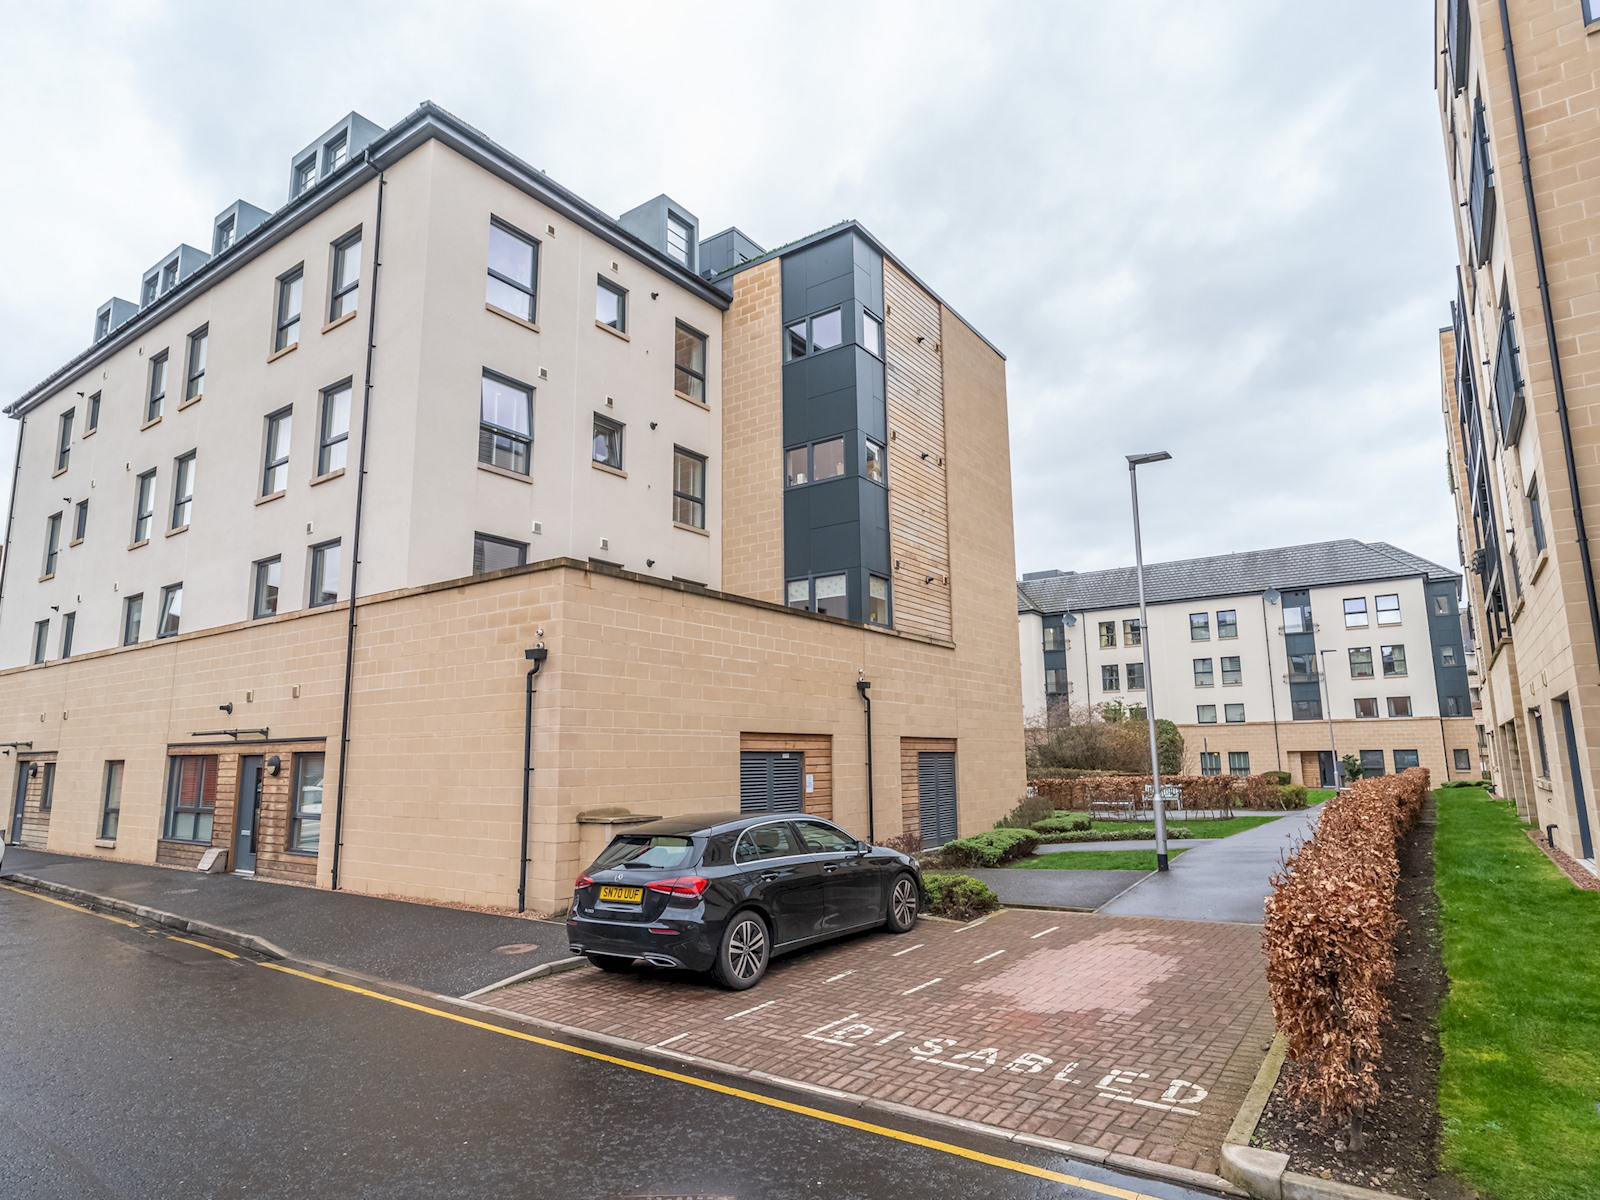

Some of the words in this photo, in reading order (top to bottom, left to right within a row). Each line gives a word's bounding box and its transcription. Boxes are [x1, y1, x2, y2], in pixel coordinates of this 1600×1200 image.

[603, 887, 623, 898] SN70
[624, 889, 640, 900] UUF
[829, 1023, 1208, 1104] DISABLED
